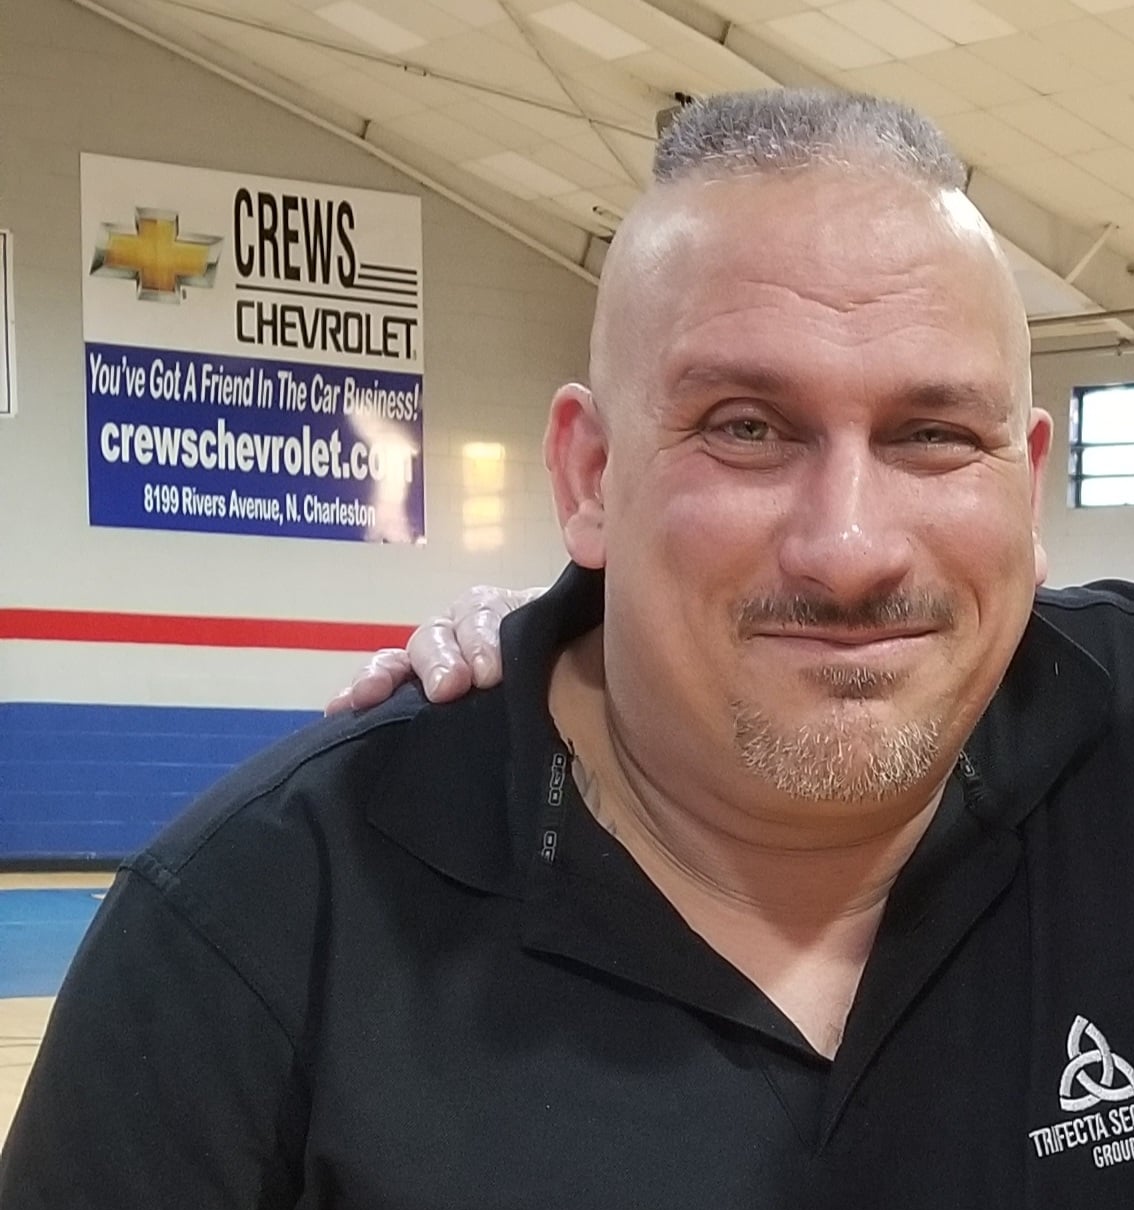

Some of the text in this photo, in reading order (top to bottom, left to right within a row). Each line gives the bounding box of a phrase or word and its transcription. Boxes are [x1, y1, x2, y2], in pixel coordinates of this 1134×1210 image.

[233, 187, 357, 288] CREWS
[235, 299, 418, 359] CHEVROLET
[89, 352, 419, 421] You've Got A Friend In The Car Business!
[143, 483, 376, 527] 8199 Rivers Avenue, N. Charleston
[1029, 1113, 1110, 1157] TRIFECTA
